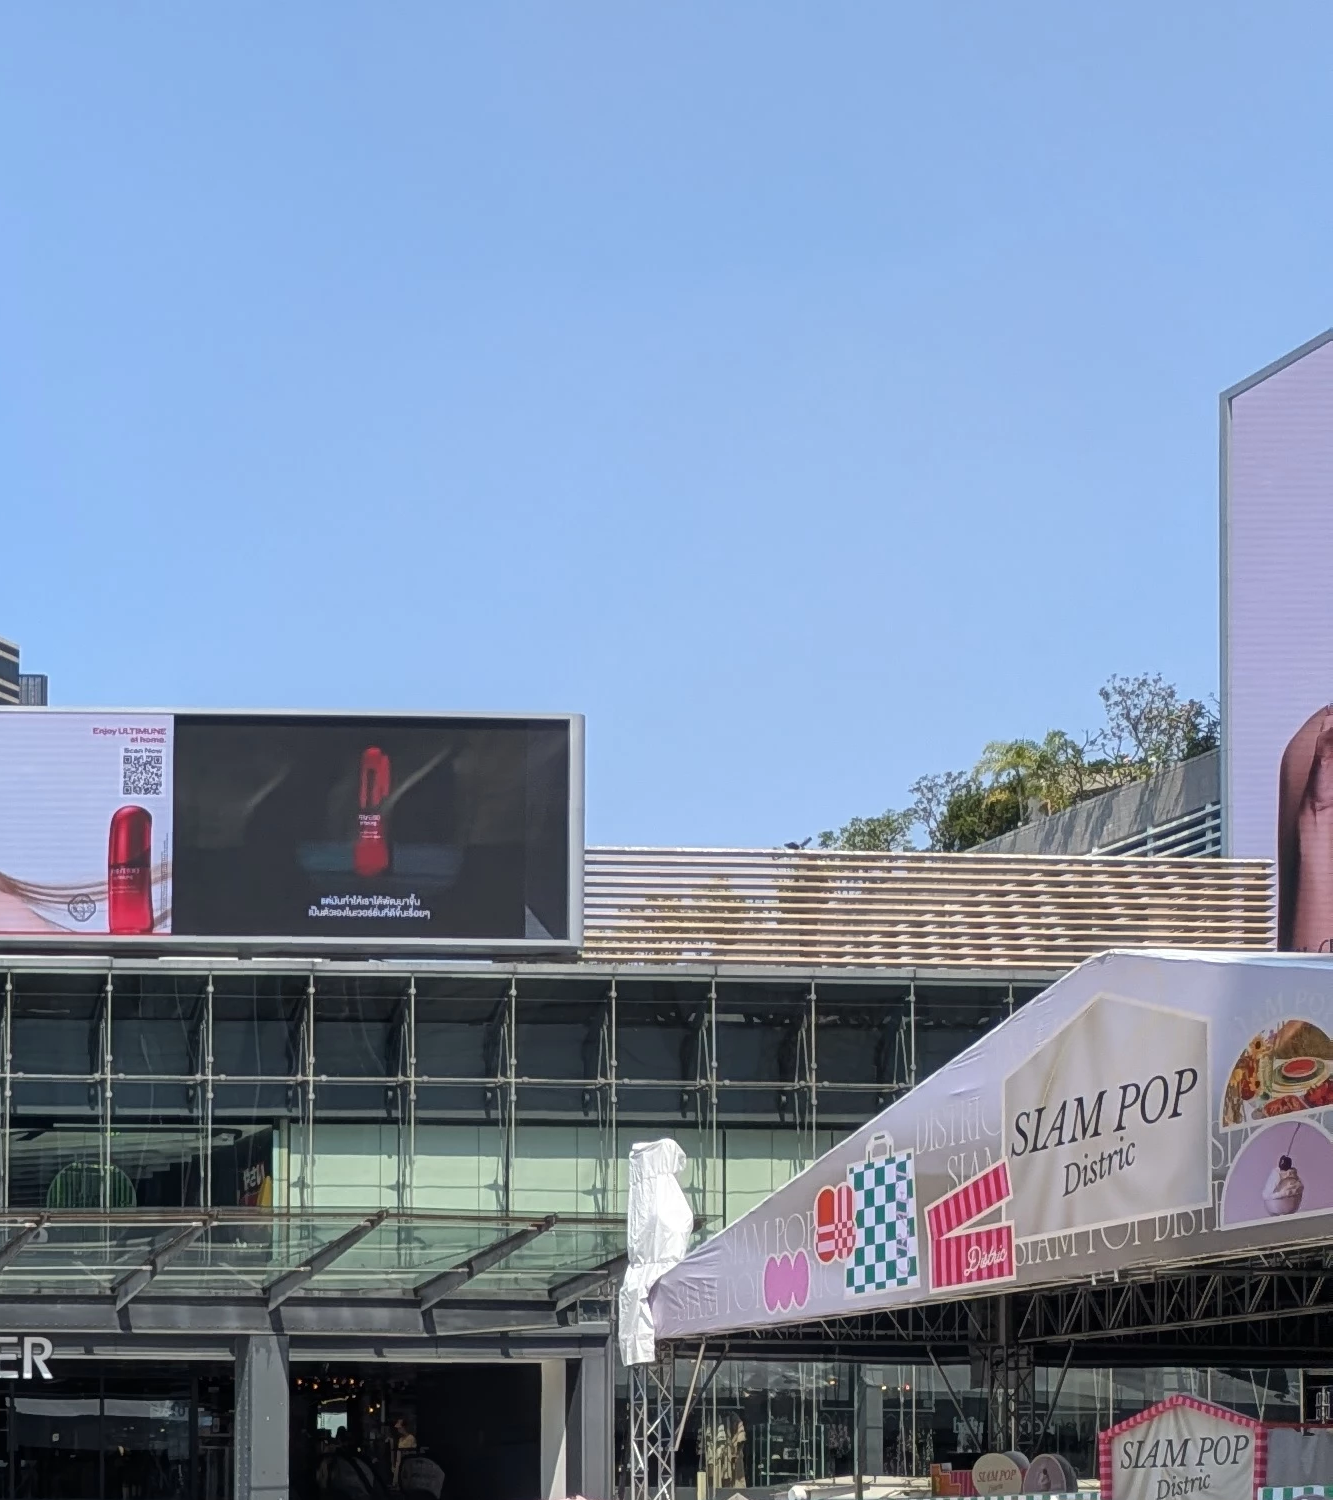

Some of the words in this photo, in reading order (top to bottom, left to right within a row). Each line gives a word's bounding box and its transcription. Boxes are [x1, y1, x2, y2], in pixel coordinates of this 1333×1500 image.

[118, 727, 167, 735] ULTIMUNE
[1010, 1089, 1107, 1158] SIAM
[1113, 1067, 1199, 1133] POP
[1062, 1136, 1136, 1199] Distric
[1120, 1438, 1189, 1470] SIAM
[1196, 1434, 1250, 1466] POP
[1156, 1468, 1211, 1500] Distric
